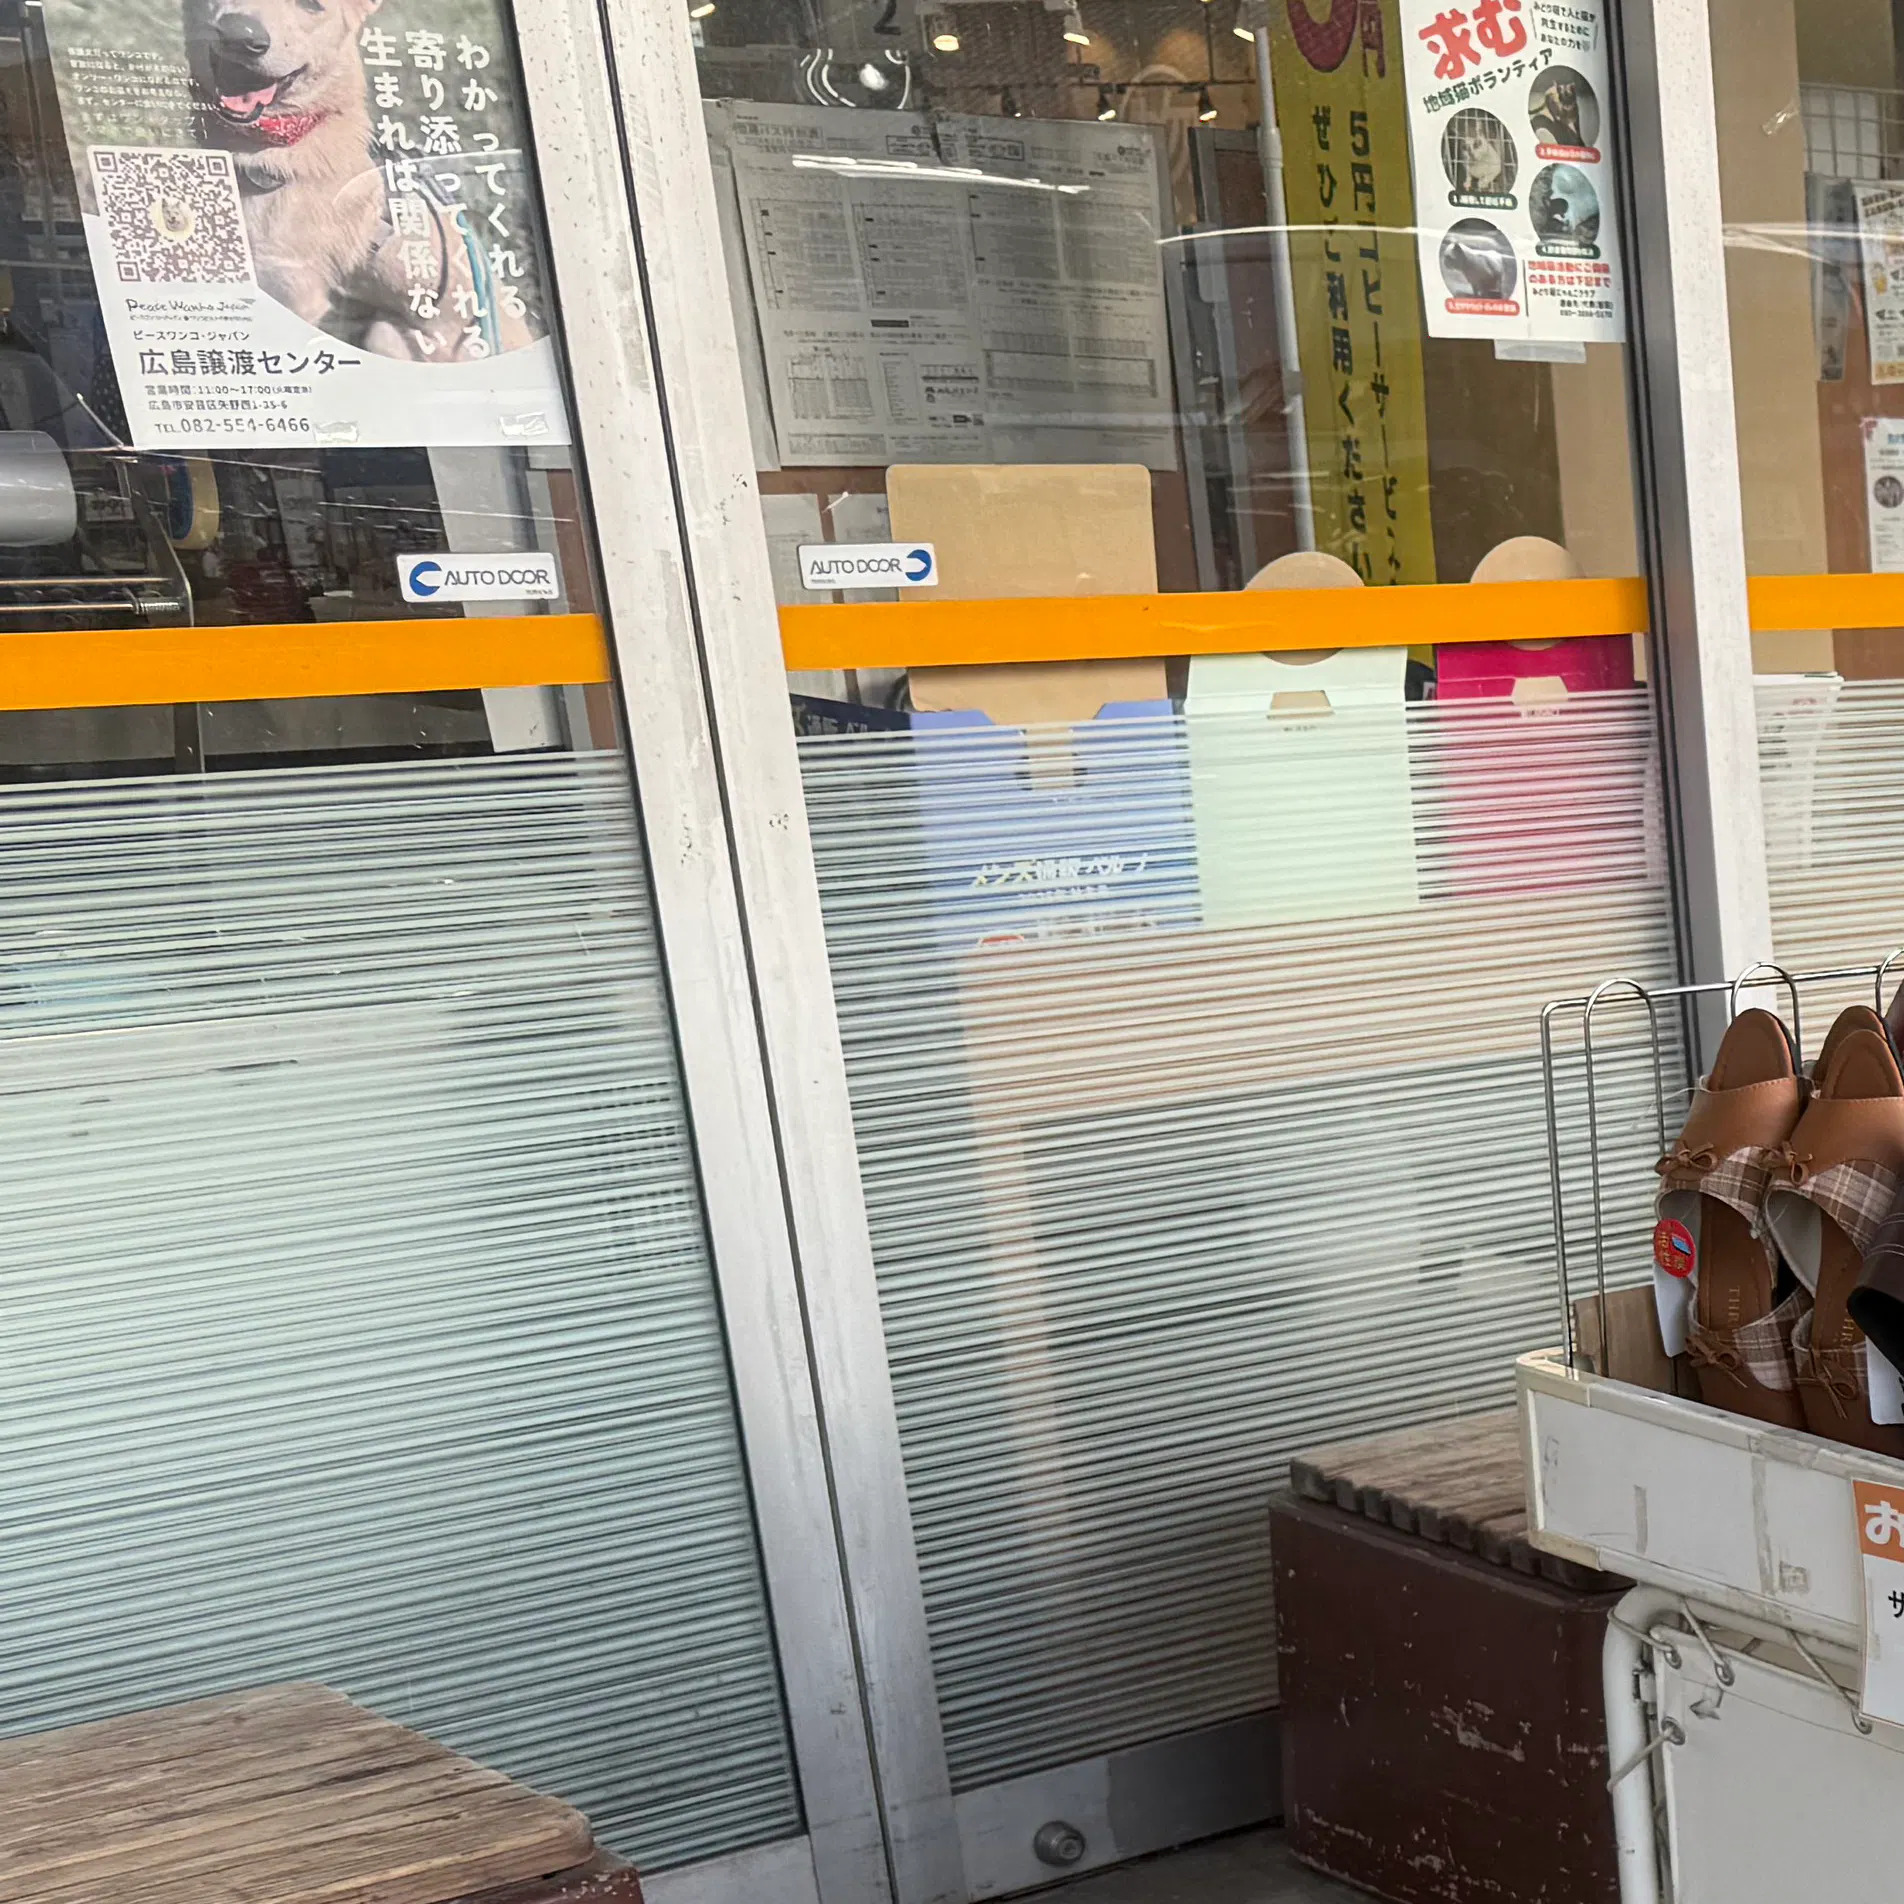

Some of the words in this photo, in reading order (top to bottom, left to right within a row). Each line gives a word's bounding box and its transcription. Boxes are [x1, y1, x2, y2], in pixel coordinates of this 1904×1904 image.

[1418, 0, 1527, 80] 求む
[1423, 47, 1553, 114] 地域猫ボランティア
[360, 27, 447, 355] 生まれは関係ない
[404, 29, 491, 359] 寄り添ってくれる
[139, 348, 361, 376] 広島譲渡センター
[444, 570, 495, 586] AUTO
[499, 569, 551, 585] DOOR
[810, 559, 855, 575] AUTO
[857, 558, 903, 574] DOOR
